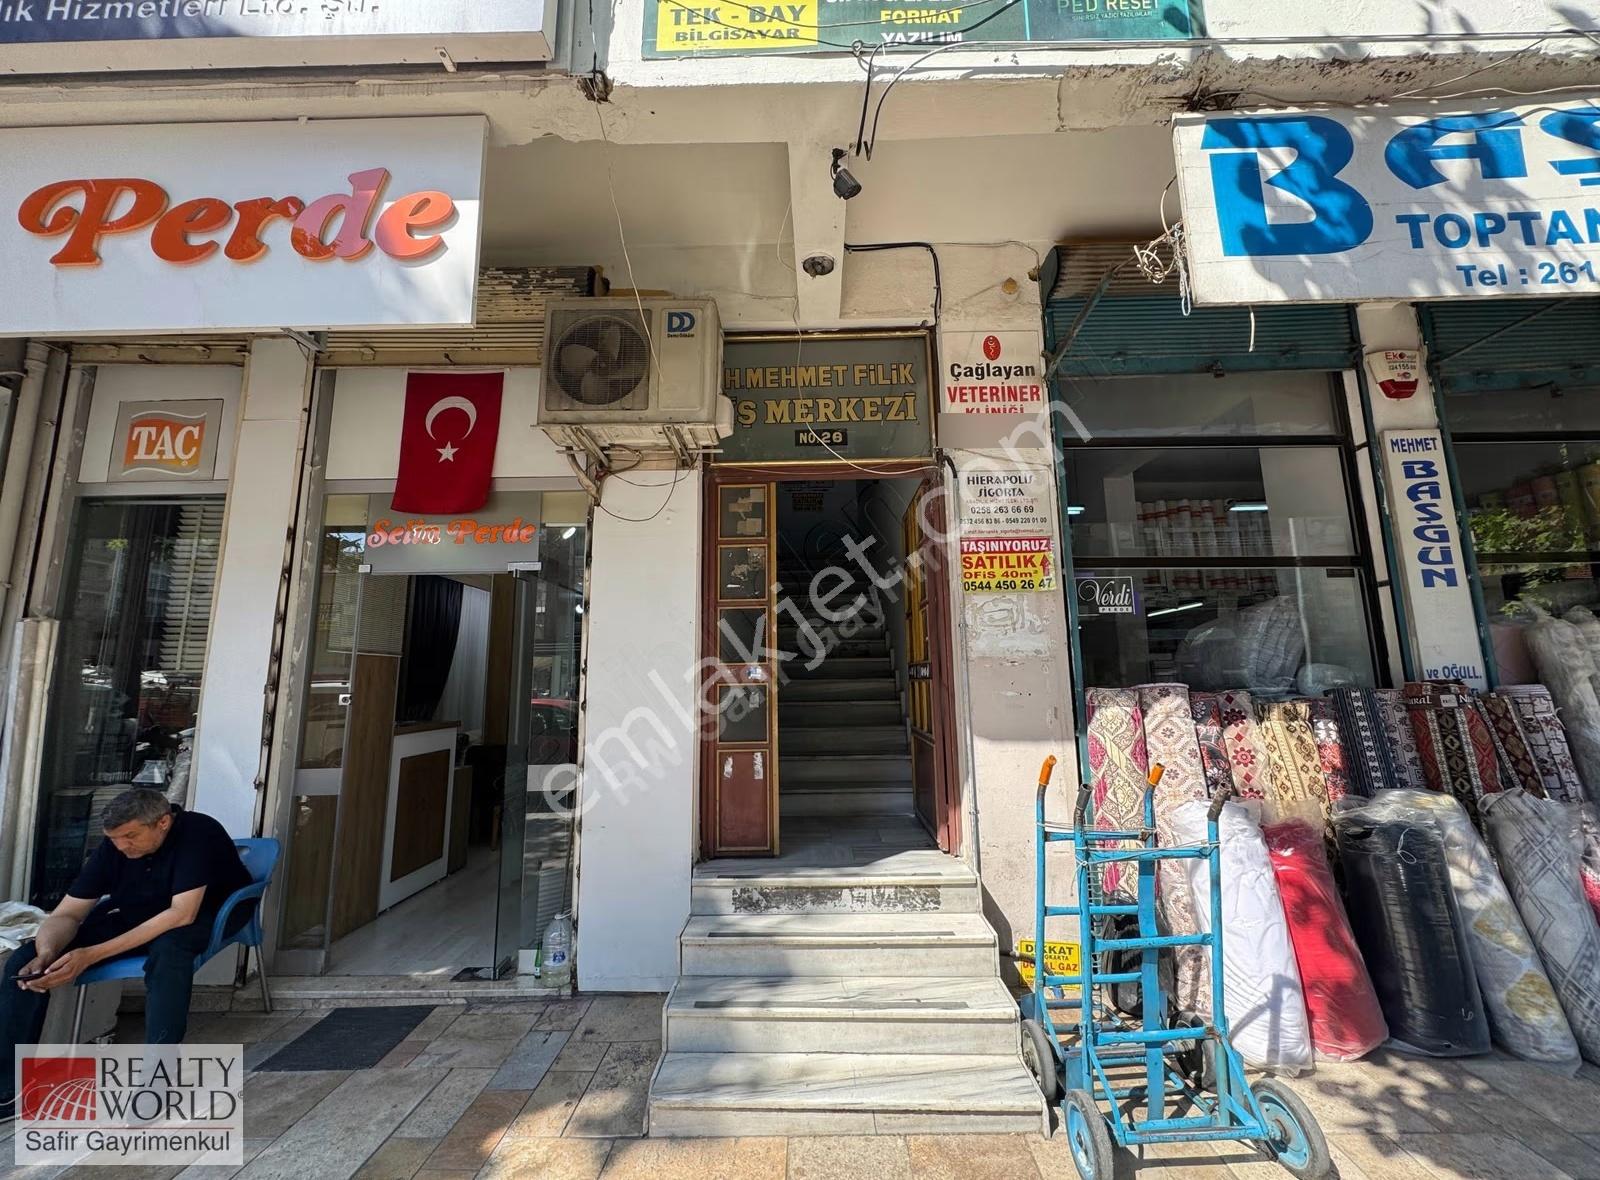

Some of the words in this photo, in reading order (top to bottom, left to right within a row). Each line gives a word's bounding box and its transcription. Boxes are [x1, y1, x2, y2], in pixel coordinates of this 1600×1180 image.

[670, 7, 720, 26] TEK
[749, 4, 807, 23] BAY
[880, 9, 963, 24] FORMAT
[675, 28, 801, 42] BİLGİSAYAR
[18, 167, 459, 266] Perde
[1456, 264, 1508, 287] Tel
[1540, 260, 1593, 285] 261
[950, 363, 1036, 381] Çağlayan
[947, 382, 1041, 403] VETERİNER
[764, 392, 918, 424] MERKEZİ
[132, 426, 200, 466] TAÇ
[1390, 437, 1439, 453] MEHMET
[994, 506, 1009, 514] 263
[1024, 505, 1034, 513] 69
[447, 516, 537, 545] Perde
[962, 540, 1048, 554] TAŞINIYORUZ
[962, 555, 1037, 570] SATILIK
[963, 581, 991, 591] 0544
[995, 580, 1017, 590] 450
[1020, 579, 1035, 589] 26
[1078, 579, 1132, 606] Verdi
[1426, 669, 1439, 679] ve
[1025, 944, 1073, 955] DKAT
[1058, 963, 1078, 971] GAZ
